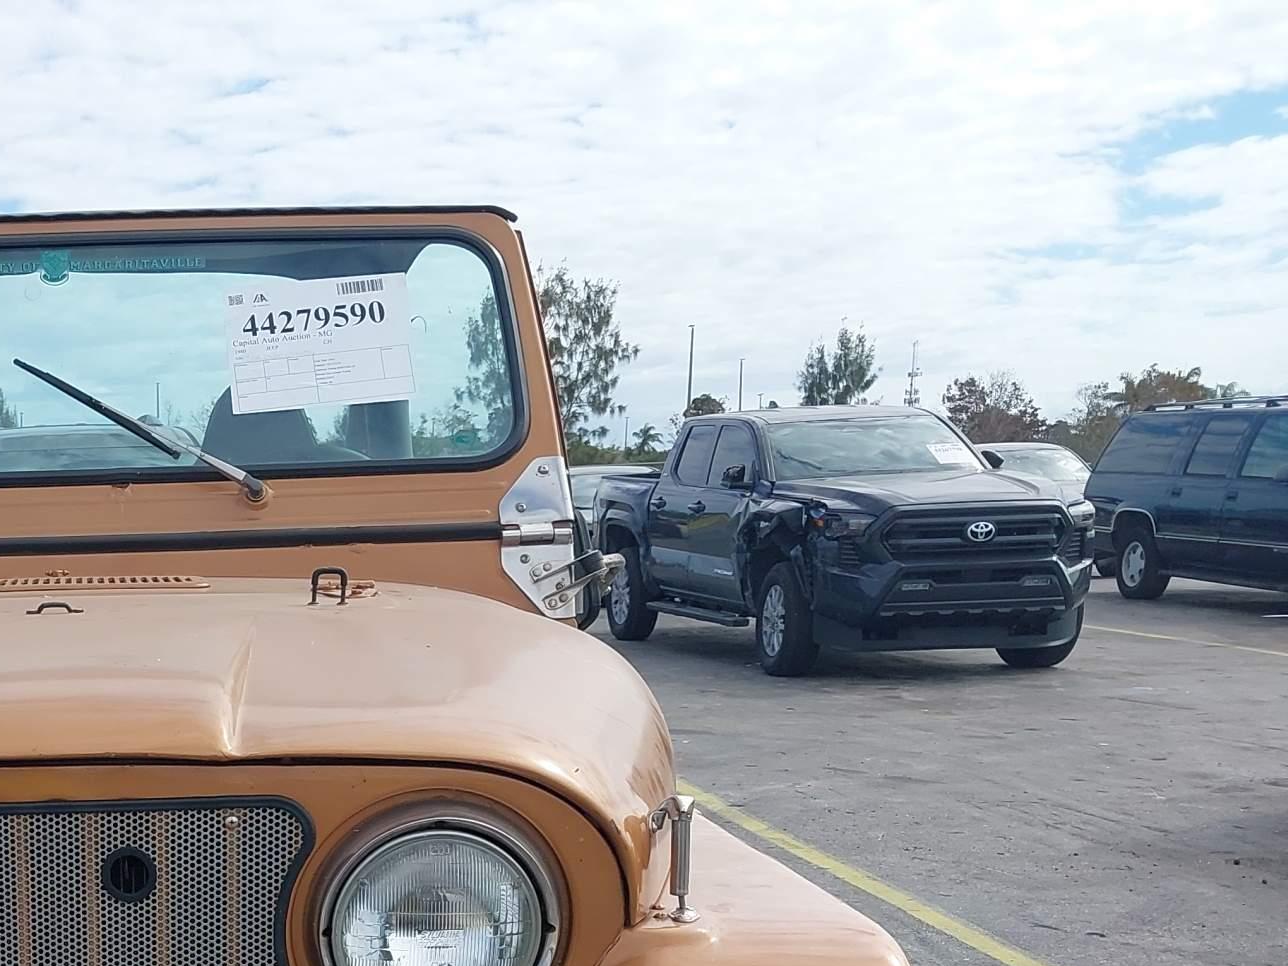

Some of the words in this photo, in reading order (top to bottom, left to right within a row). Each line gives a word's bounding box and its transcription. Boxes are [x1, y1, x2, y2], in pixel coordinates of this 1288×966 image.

[69, 257, 202, 271] MARGARITAVILLE
[242, 301, 385, 336] 44279590
[232, 338, 260, 347] Capital
[262, 336, 280, 344] Auto
[282, 333, 311, 342] Auction
